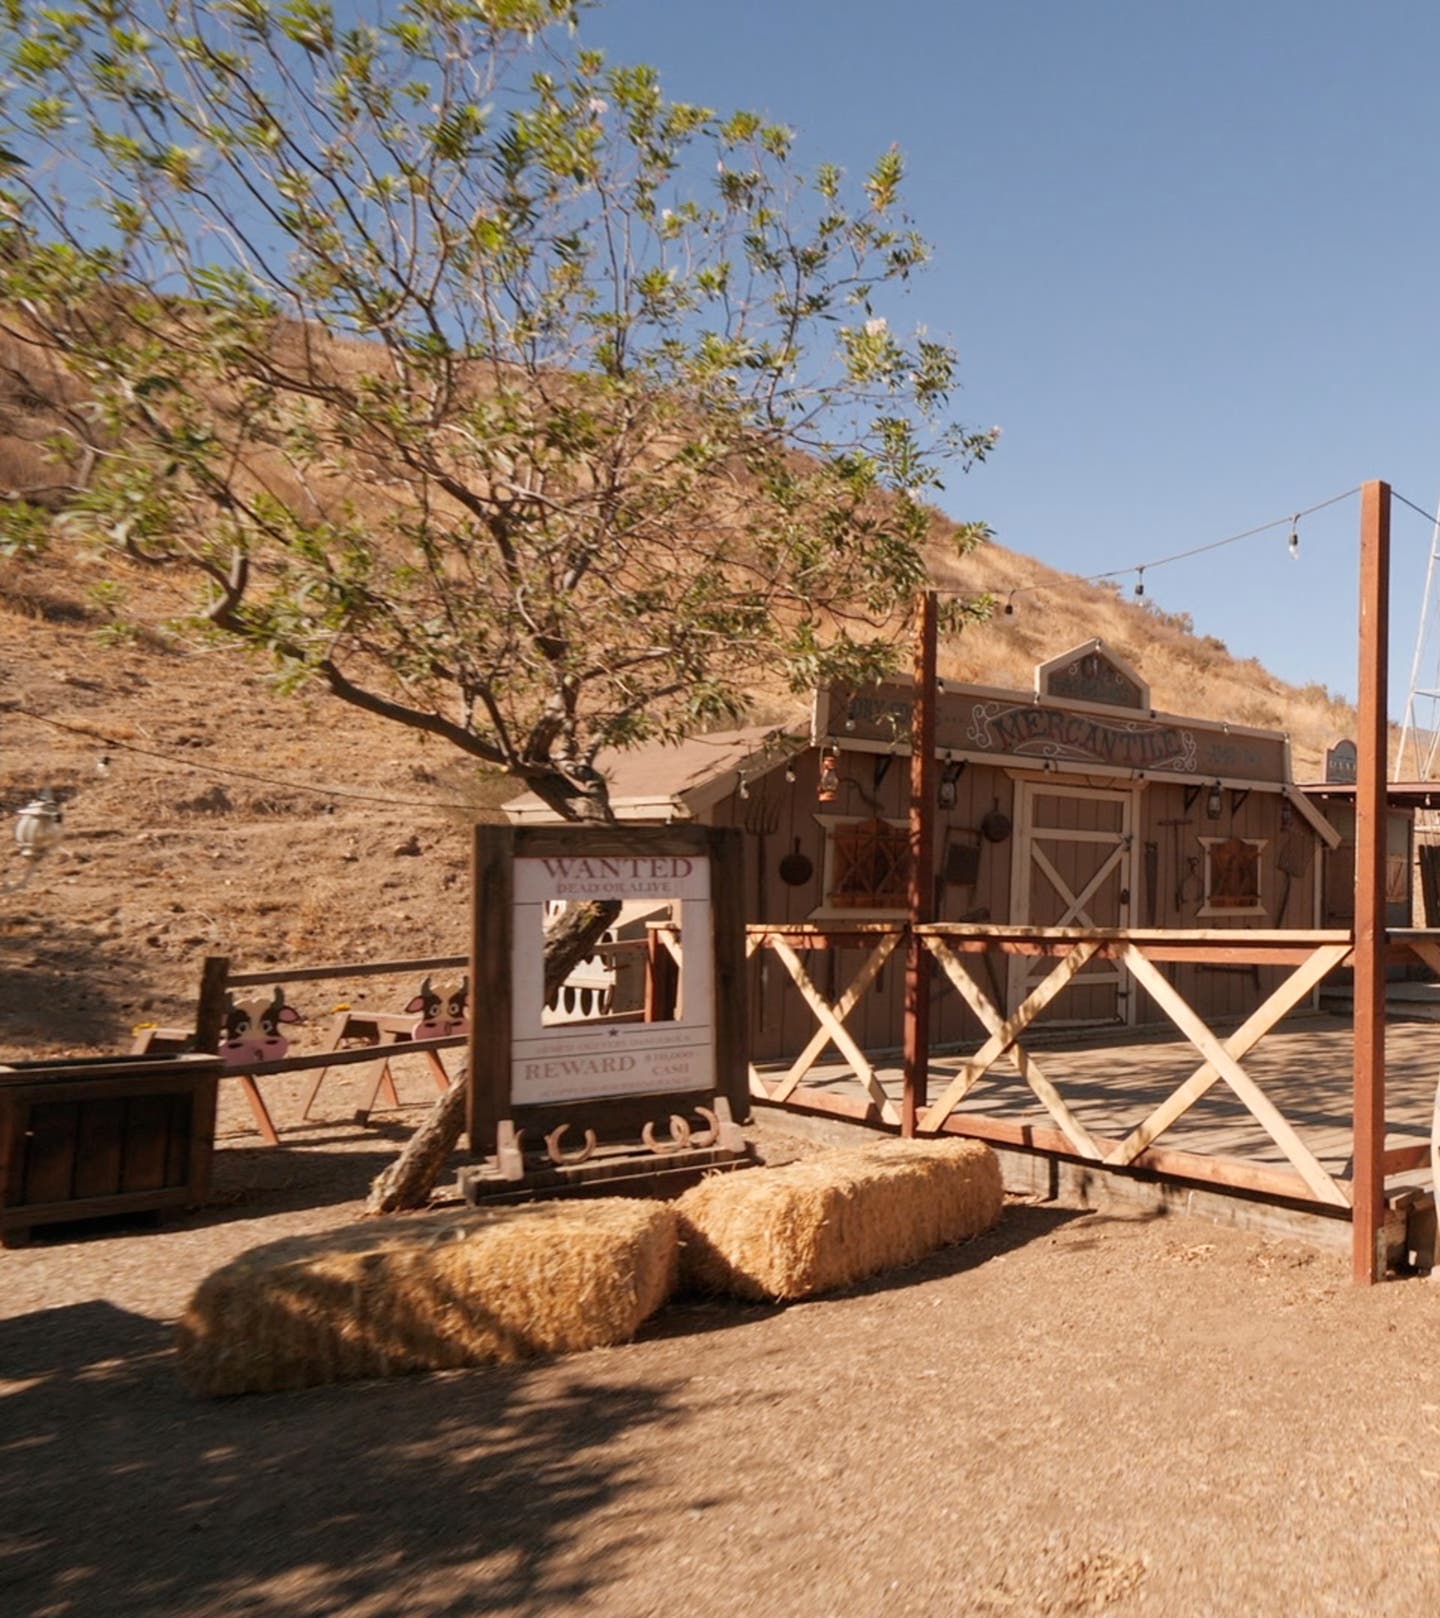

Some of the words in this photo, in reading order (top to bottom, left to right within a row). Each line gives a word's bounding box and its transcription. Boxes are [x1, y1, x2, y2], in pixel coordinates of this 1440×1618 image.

[991, 706, 1182, 764] MERCANTILE
[541, 858, 693, 879] WANTED
[557, 882, 599, 894] DEAD
[602, 882, 625, 893] OR
[631, 882, 673, 893] ALIVE
[525, 1055, 637, 1081] REWARD
[651, 1063, 691, 1077] CASH
